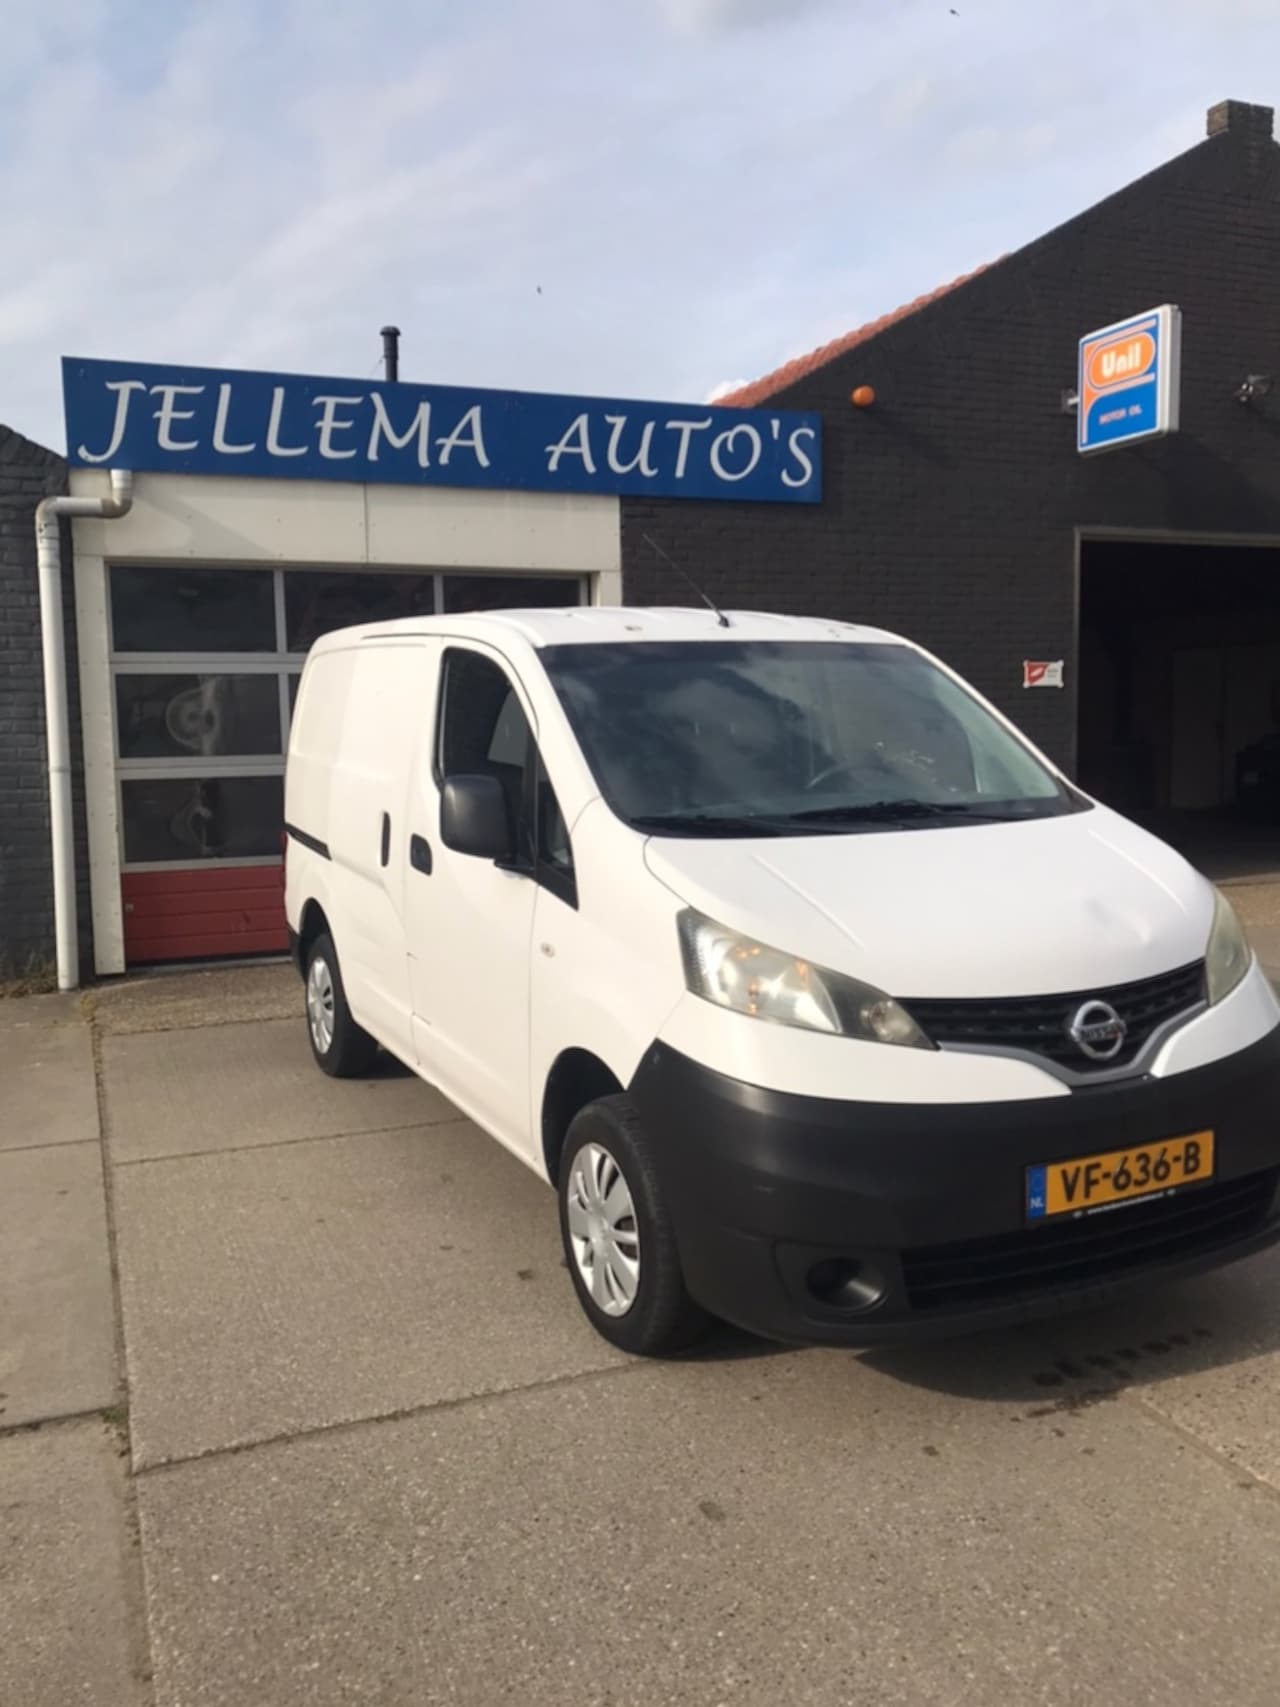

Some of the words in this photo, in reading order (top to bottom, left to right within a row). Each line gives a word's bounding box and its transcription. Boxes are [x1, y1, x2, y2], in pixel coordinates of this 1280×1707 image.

[1102, 342, 1141, 378] Unil
[77, 380, 490, 468] JELLEMA
[544, 412, 815, 487] AUTO'S
[1061, 1140, 1201, 1203] VF-636-B
[1030, 1196, 1044, 1209] NL
